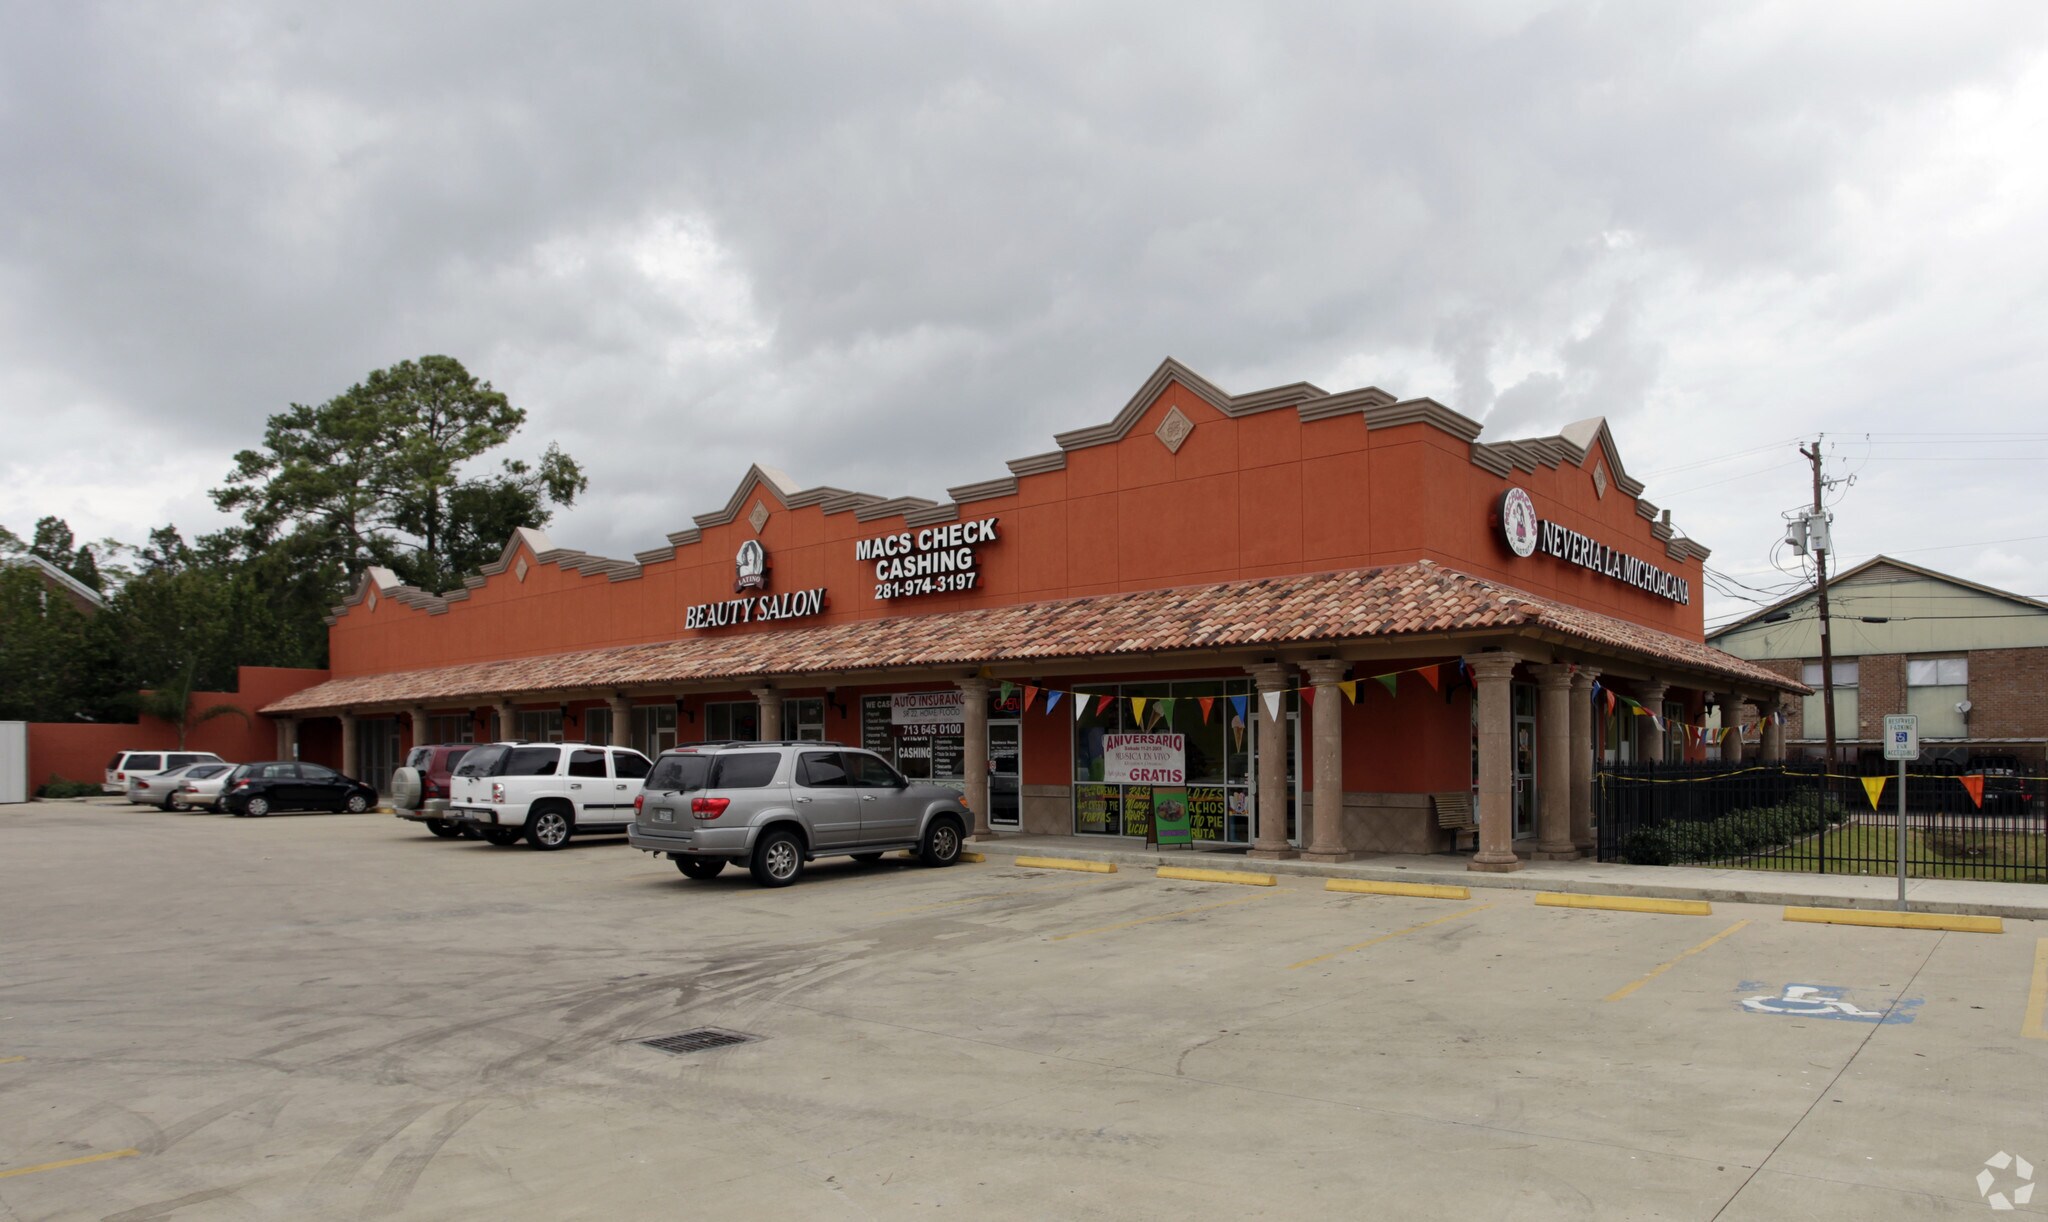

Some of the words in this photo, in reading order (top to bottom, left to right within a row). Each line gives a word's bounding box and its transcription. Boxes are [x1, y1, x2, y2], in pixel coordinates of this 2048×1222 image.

[856, 533, 912, 561] MACS
[918, 518, 997, 550] CHECK
[876, 548, 973, 581] CASHING
[1542, 519, 1602, 572] NEVERIA
[1605, 546, 1621, 580] LA
[1623, 554, 1689, 605] MICHOACANA
[738, 576, 761, 586] LATINO
[875, 573, 976, 600] 281-974-3197
[685, 598, 756, 630] BEAUTY
[757, 588, 825, 622] SALON
[865, 701, 876, 709] WE
[877, 700, 891, 708] CAS
[893, 696, 916, 708] AUTO
[919, 693, 965, 706] INSURANC
[993, 697, 1020, 711] OPEN
[903, 725, 919, 735] 713
[921, 724, 937, 735] 645
[939, 724, 961, 735] 0100
[1106, 735, 1182, 752] ANIVERSARIO
[899, 747, 931, 758] CASHING
[1116, 752, 1141, 761] MUSICA
[1144, 752, 1152, 761] EN
[1154, 752, 1171, 761] VIVO
[1129, 768, 1183, 782] GRATIS
[1129, 786, 1150, 796] RAS
[1187, 788, 1224, 799] LOTES
[1109, 801, 1119, 811] PIE
[1189, 801, 1224, 814] ACHOS
[1082, 812, 1111, 823] TORTAS
[1190, 815, 1205, 827] ITO
[1207, 815, 1223, 828] PIE
[1127, 823, 1149, 834] LICUA
[1191, 828, 1216, 839] RUTA
